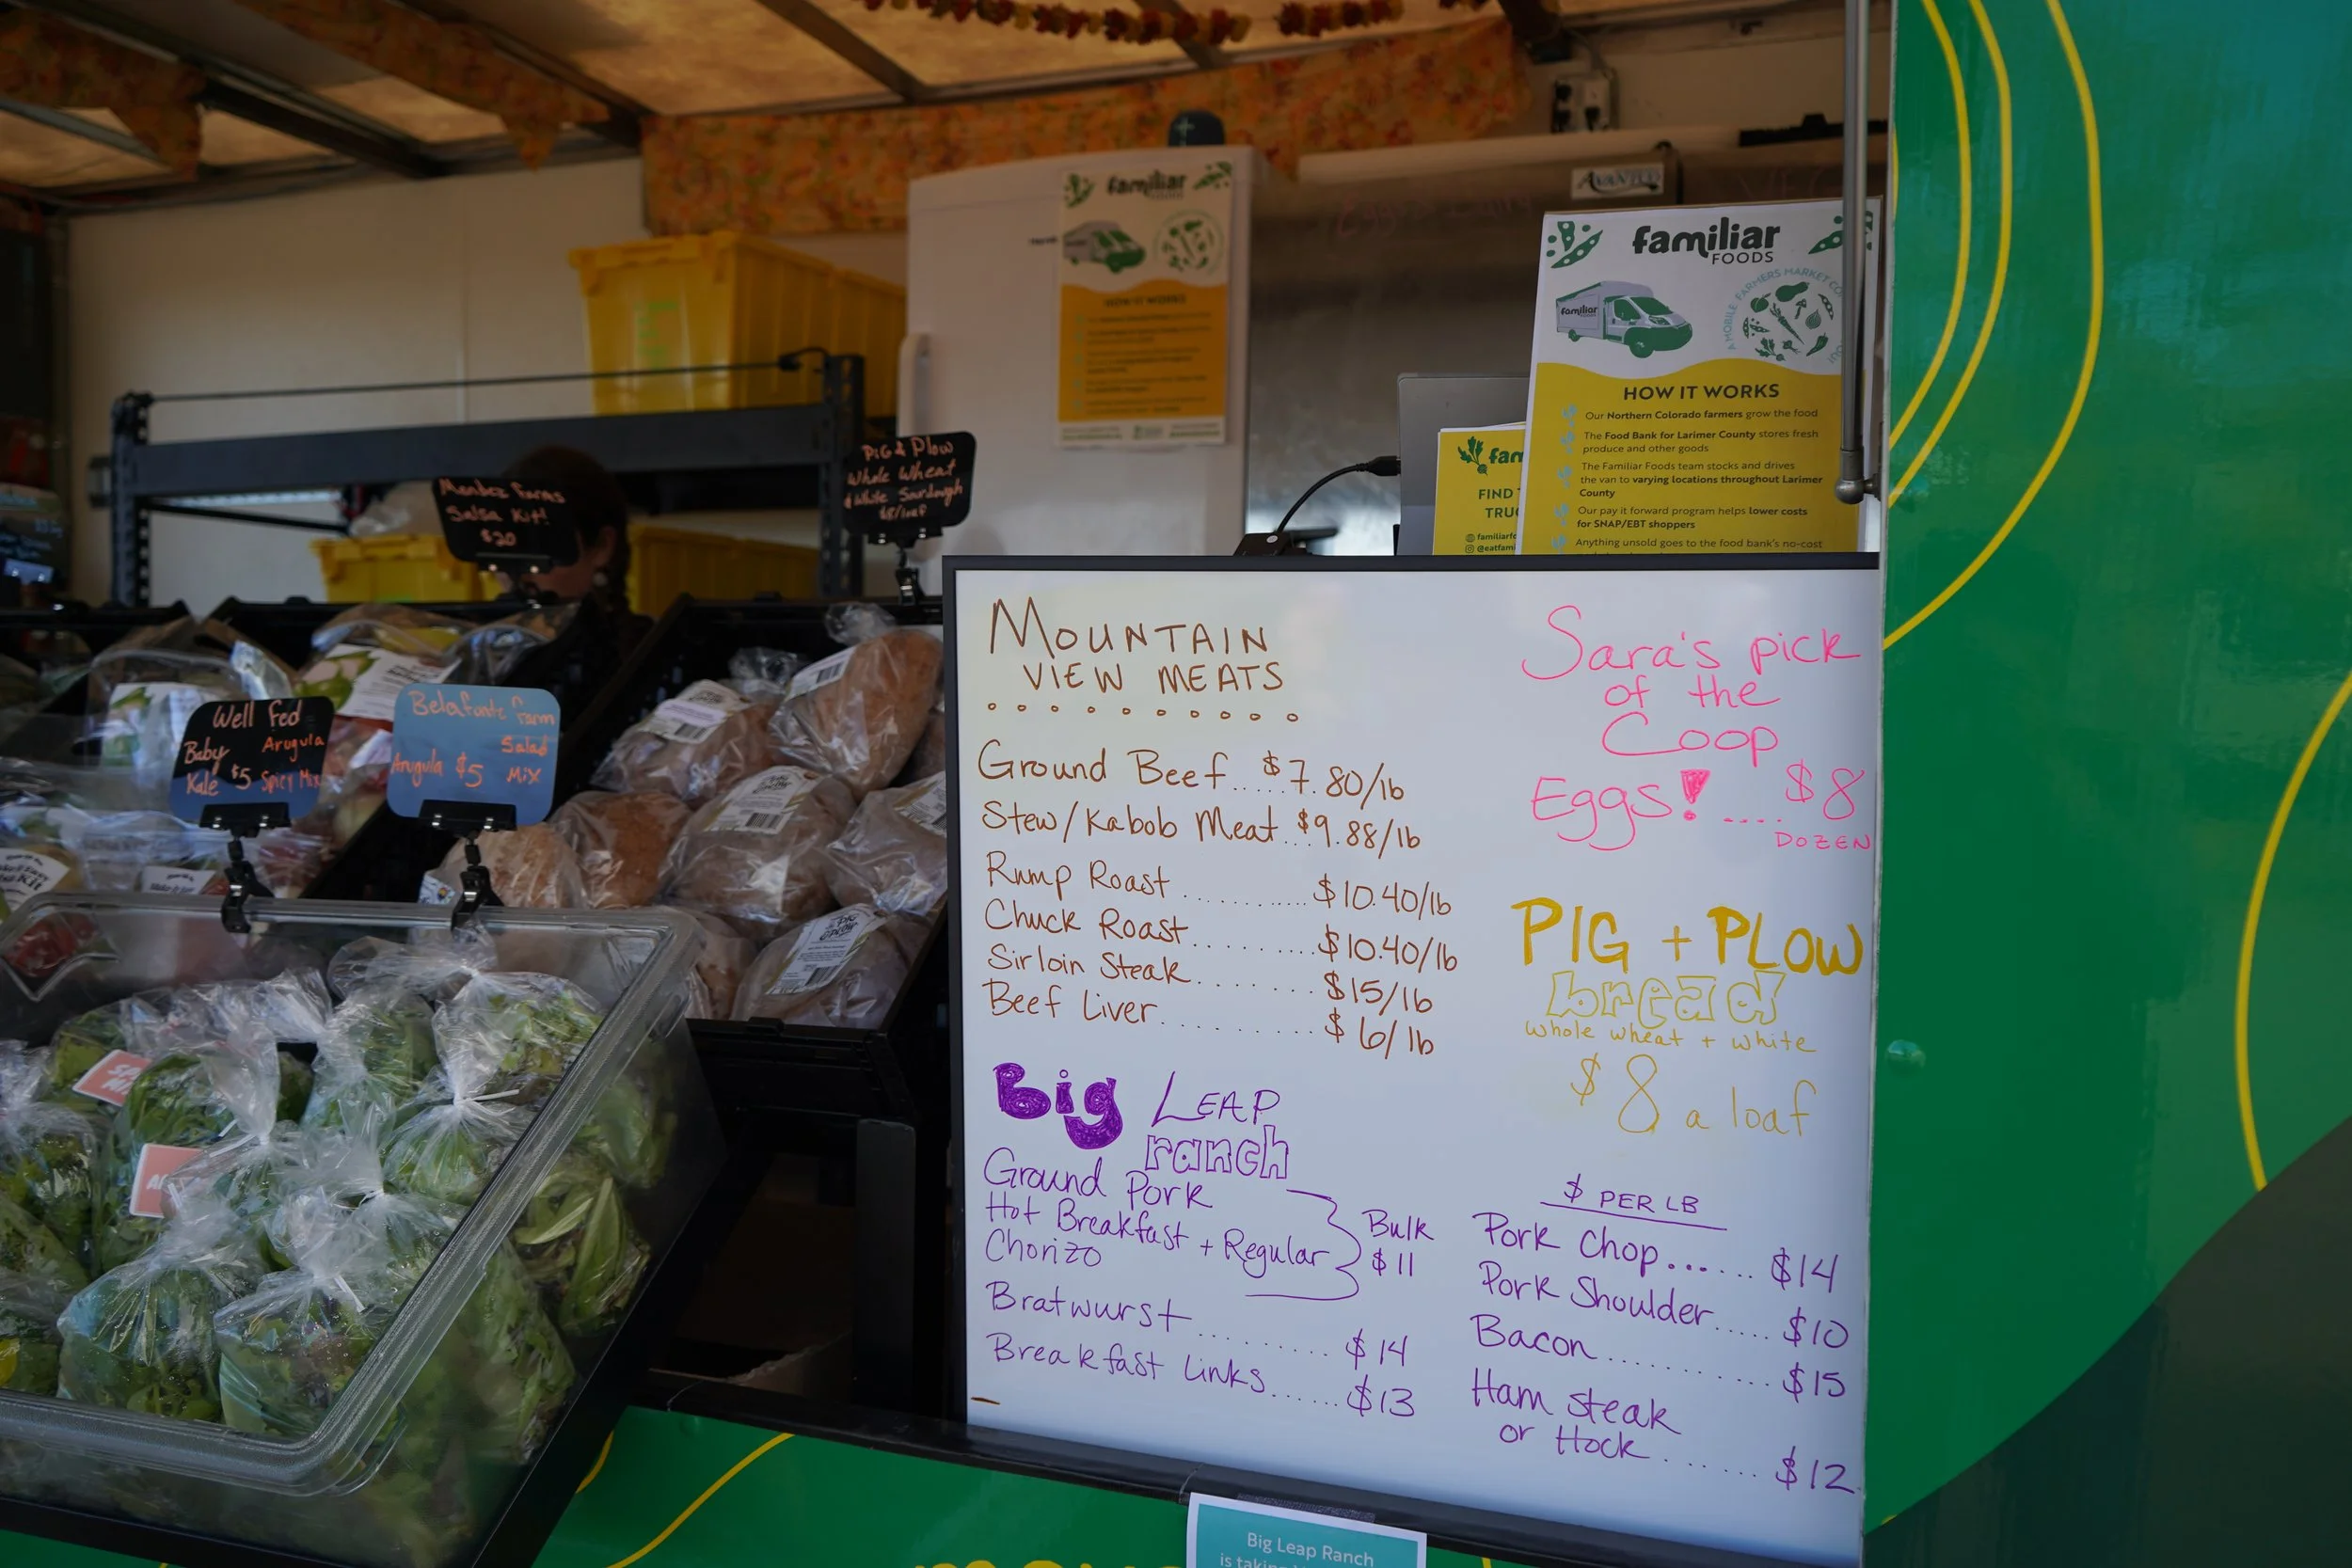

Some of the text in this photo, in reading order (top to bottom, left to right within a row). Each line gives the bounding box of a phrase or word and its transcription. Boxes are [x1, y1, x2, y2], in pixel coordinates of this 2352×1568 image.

[1632, 216, 1781, 259] familiar
[1712, 251, 1773, 265] FOODS
[1561, 304, 1598, 316] familiar
[1723, 303, 1738, 342] MOBILE
[1735, 269, 1782, 301] FARMERS
[1784, 267, 1831, 282] MARKET
[1624, 384, 1780, 401] HOW IT WORKS
[1585, 408, 1819, 420] Our Northern Colorado farmers grow the food
[1582, 443, 1709, 454] produce and other goods
[1584, 429, 1819, 440] The Food Bank for Larimer County stores fresh
[1581, 461, 1795, 470] The Familiar Foods team stocks and drives
[1632, 476, 1669, 485] varying
[1672, 475, 1718, 483] locations
[1721, 475, 1779, 485] throughout
[1782, 475, 1823, 483] Larimer
[1478, 488, 1514, 499] FIND
[1578, 506, 1808, 516] Our pay forward program helps lower costs
[1580, 488, 1616, 499] County
[1576, 537, 1822, 548] Anything unsold goes the food bank's no-cost
[1577, 519, 1696, 531] for SNAP/EBT shoppers
[991, 596, 1267, 659] MOUNTAIN
[1522, 605, 1862, 681] Sara's pick
[1023, 661, 1283, 694] VIEW MEATS
[1604, 674, 1781, 708] of the
[213, 700, 254, 729] Well
[183, 733, 326, 776] Baby Arugula
[501, 734, 548, 757] Salad
[1601, 711, 1779, 768] Coop
[186, 770, 220, 797] Kale
[455, 752, 484, 788] $5
[978, 739, 1106, 783] Ground
[1127, 749, 1228, 789] Beef
[1785, 759, 1865, 820] $8
[1196, 804, 1279, 842] Meat
[1775, 832, 1871, 850] DOZEN
[986, 850, 1451, 920] Rump Roast $10.40/lb
[985, 898, 1457, 974] Chuck Roast $10.40/lb
[1510, 896, 1865, 976] PIG + PLOW
[988, 942, 1433, 1016] Sirloin Steak $15/lb
[982, 978, 1061, 1018] Beef
[1084, 990, 1157, 1023] Liver
[1546, 970, 1787, 1029] bread
[1525, 1020, 1818, 1053] whole wheat + white
[993, 1062, 1280, 1149] Big LEAP
[1685, 1109, 1709, 1130] a
[1732, 1079, 1818, 1137] loaf
[1145, 1125, 1289, 1179] ranch
[984, 1147, 1213, 1211] Ground Pork
[1565, 1173, 1699, 1213] $ PER LB
[986, 1191, 1330, 1278] Hot Breakfast + Regular
[1362, 1209, 1435, 1242] Bulk
[986, 1228, 1102, 1267] Chorizo
[1372, 1250, 1414, 1277] $11
[1472, 1212, 1838, 1293] Pork Chop $14
[1478, 1260, 1849, 1349] Pork Shoulder $10
[985, 1281, 1407, 1370] Bratwurst $14
[985, 1332, 1165, 1381] Breakfast
[1346, 1374, 1415, 1418] $13
[1470, 1313, 1846, 1403] Bacon $15
[1471, 1367, 1554, 1416] Ham
[1500, 1424, 1855, 1495] or Hock $12
[1219, 1553, 1232, 1567] is
[1248, 1532, 1374, 1567] Big Leap Ranch
